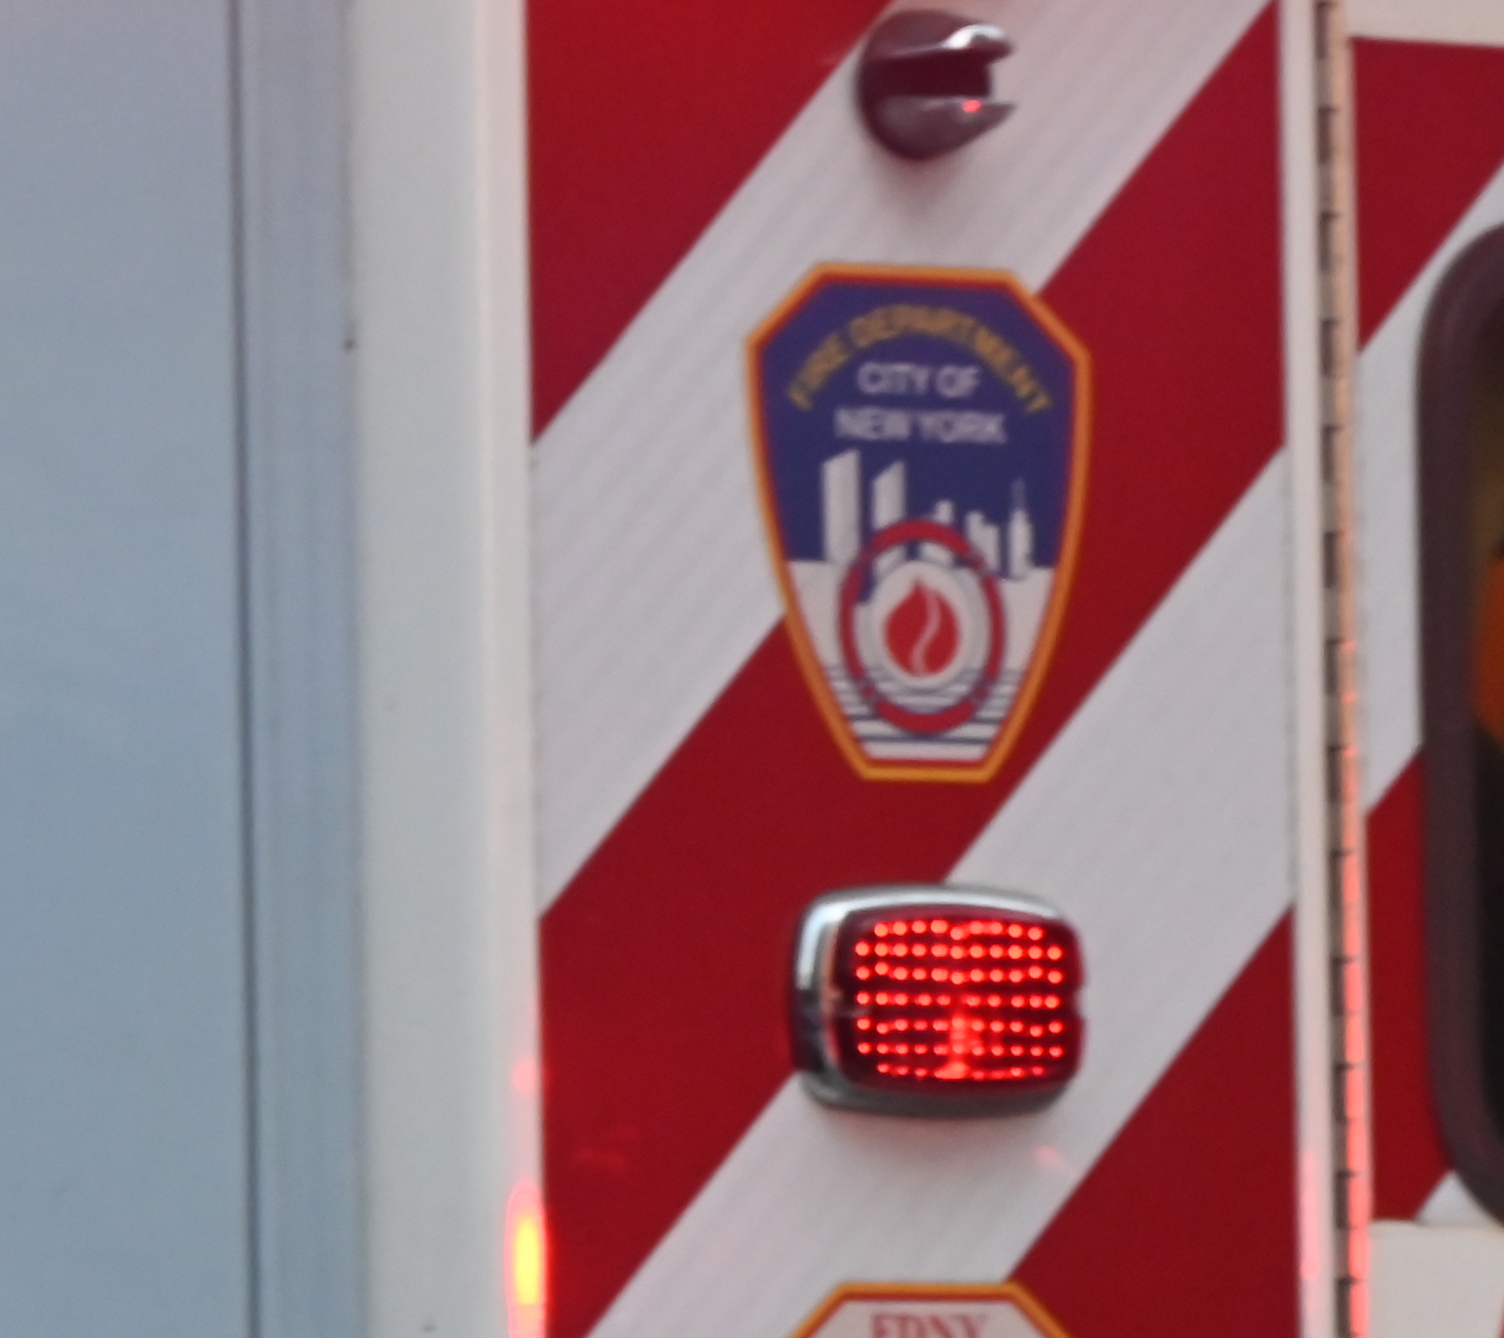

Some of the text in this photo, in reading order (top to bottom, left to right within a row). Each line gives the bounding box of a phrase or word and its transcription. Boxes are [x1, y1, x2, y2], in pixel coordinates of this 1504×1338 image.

[857, 361, 981, 398] CITY OF
[834, 407, 1007, 445] NEW YORK
